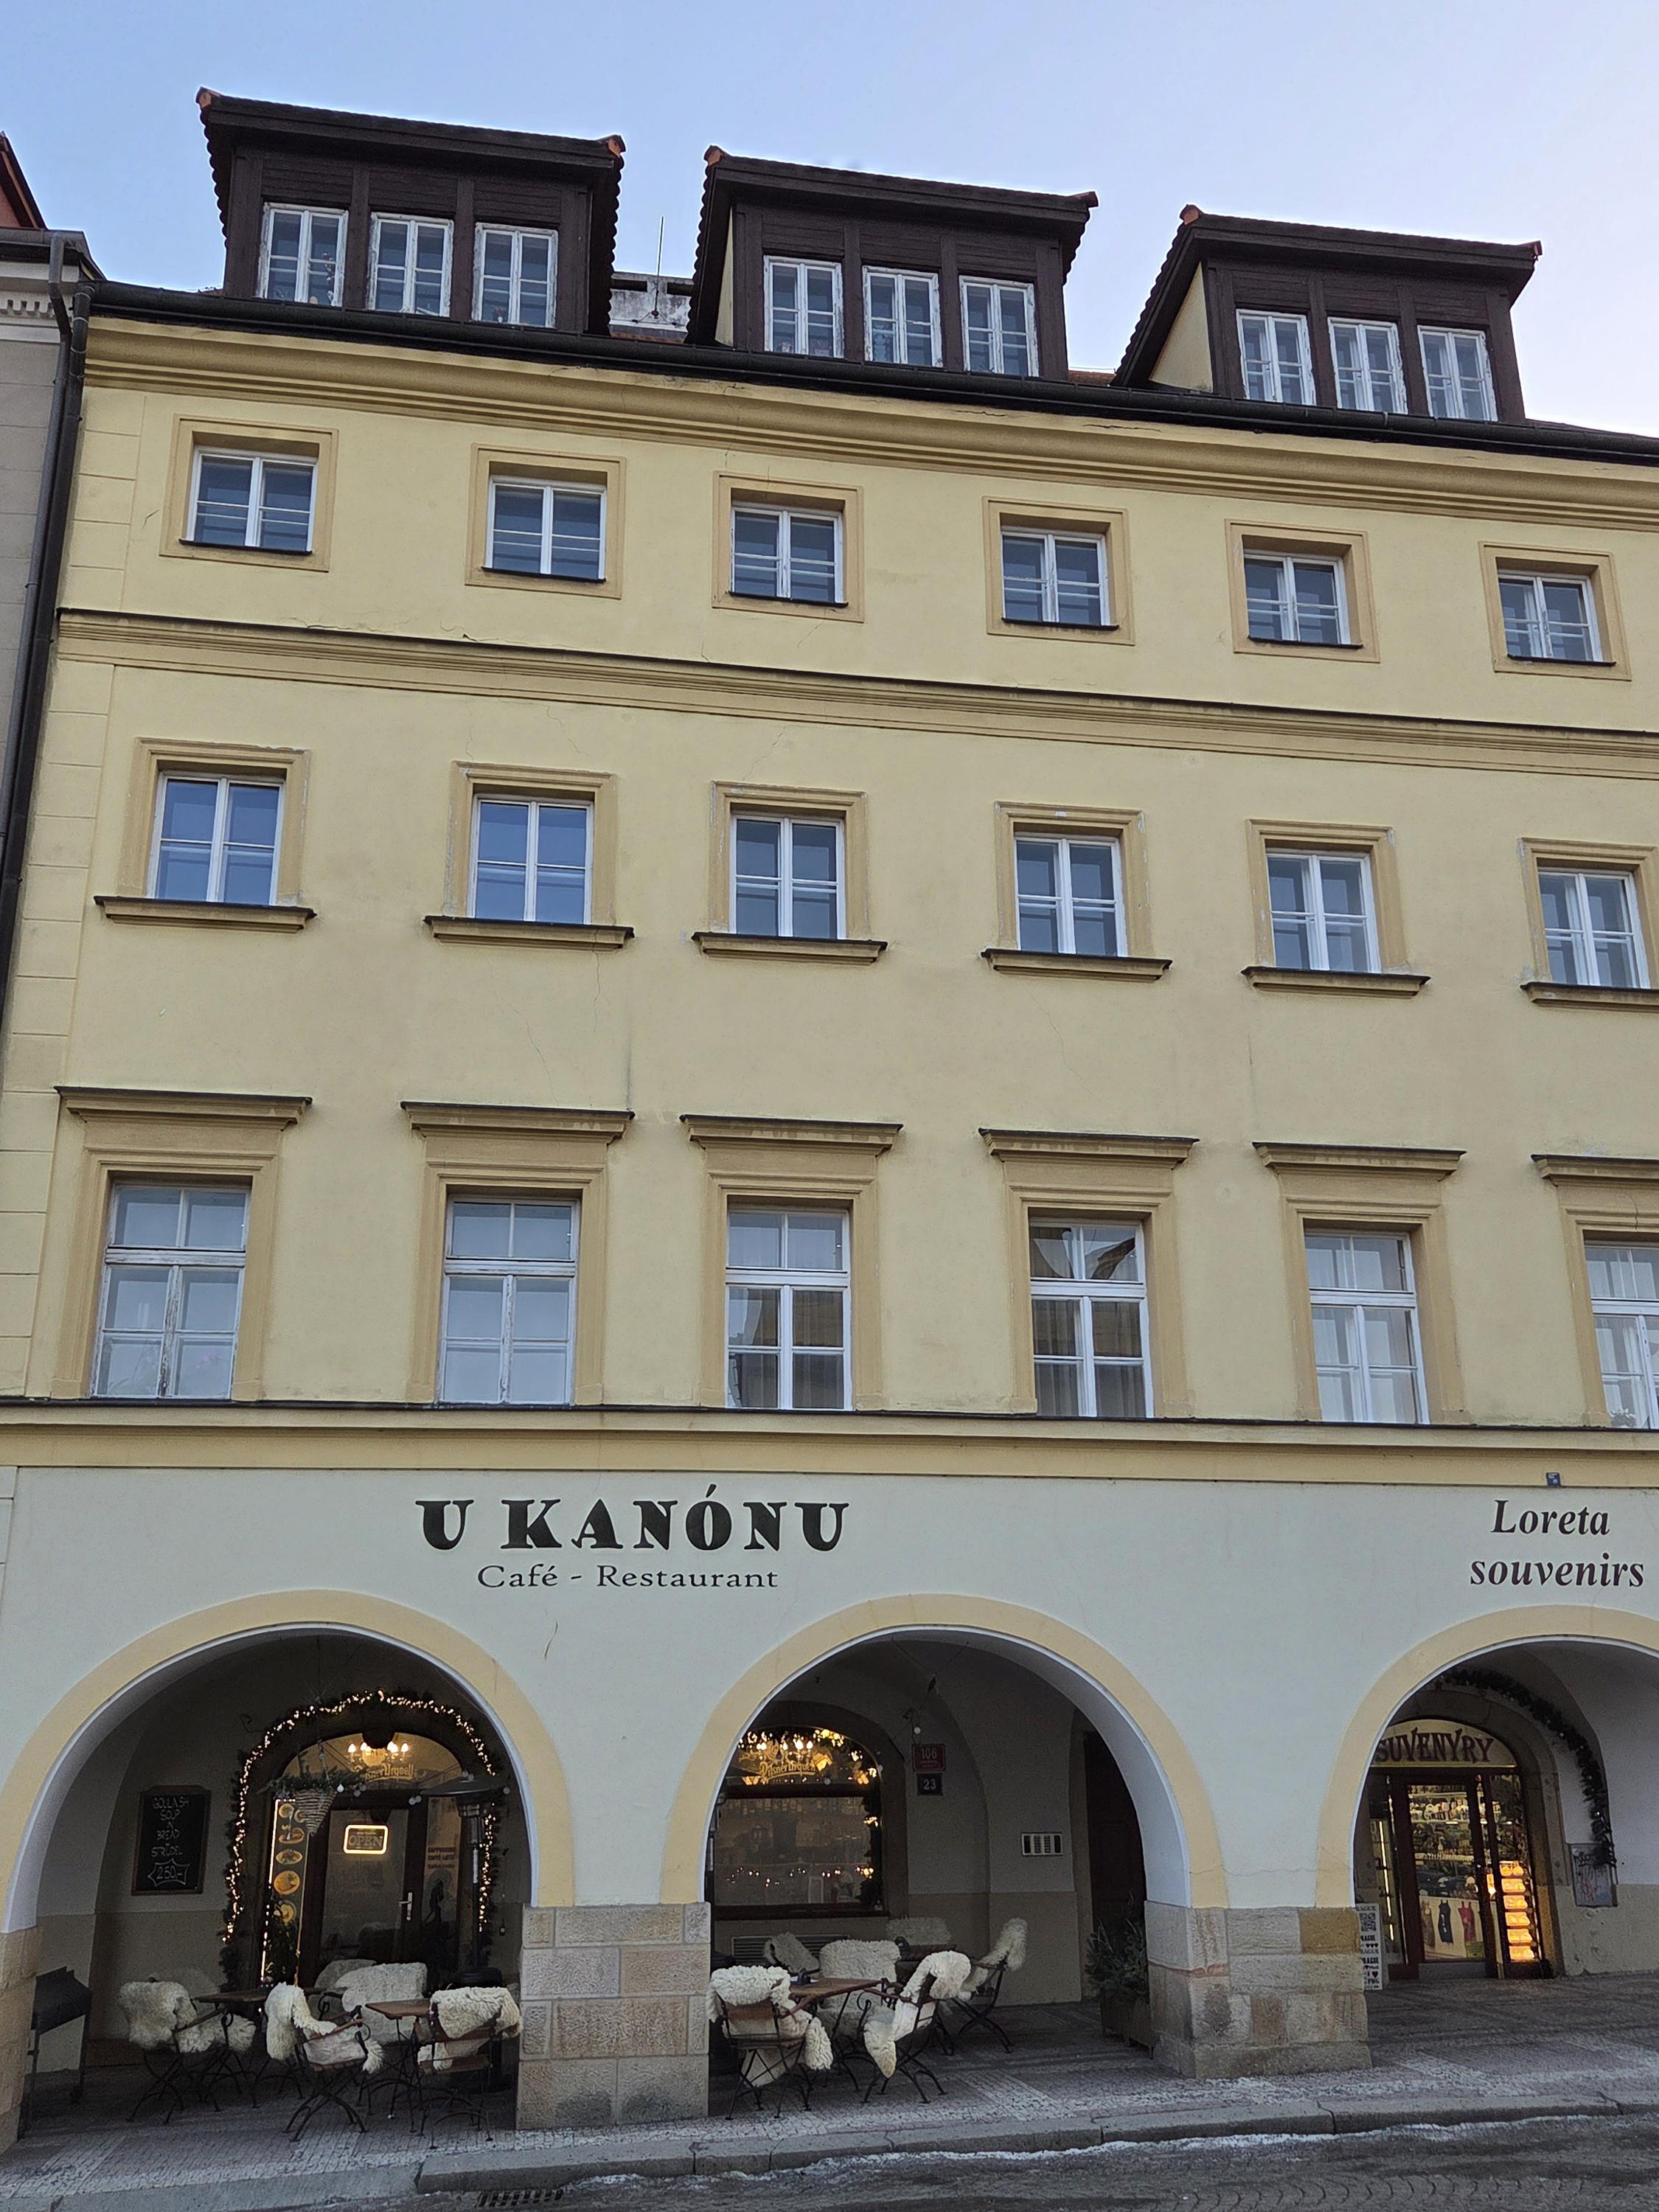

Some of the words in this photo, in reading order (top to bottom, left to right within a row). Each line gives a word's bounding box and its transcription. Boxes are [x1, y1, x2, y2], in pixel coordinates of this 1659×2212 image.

[415, 1500, 474, 1551] U
[501, 1484, 849, 1551] KANÓNU
[1491, 1500, 1610, 1536] Loreta
[478, 1563, 558, 1588] Café
[597, 1565, 779, 1588] Restaurant
[1470, 1553, 1644, 1587] souvenirs
[921, 1747, 937, 1759] 106
[924, 1778, 936, 1790] 23
[349, 1835, 383, 1847] OPEN
